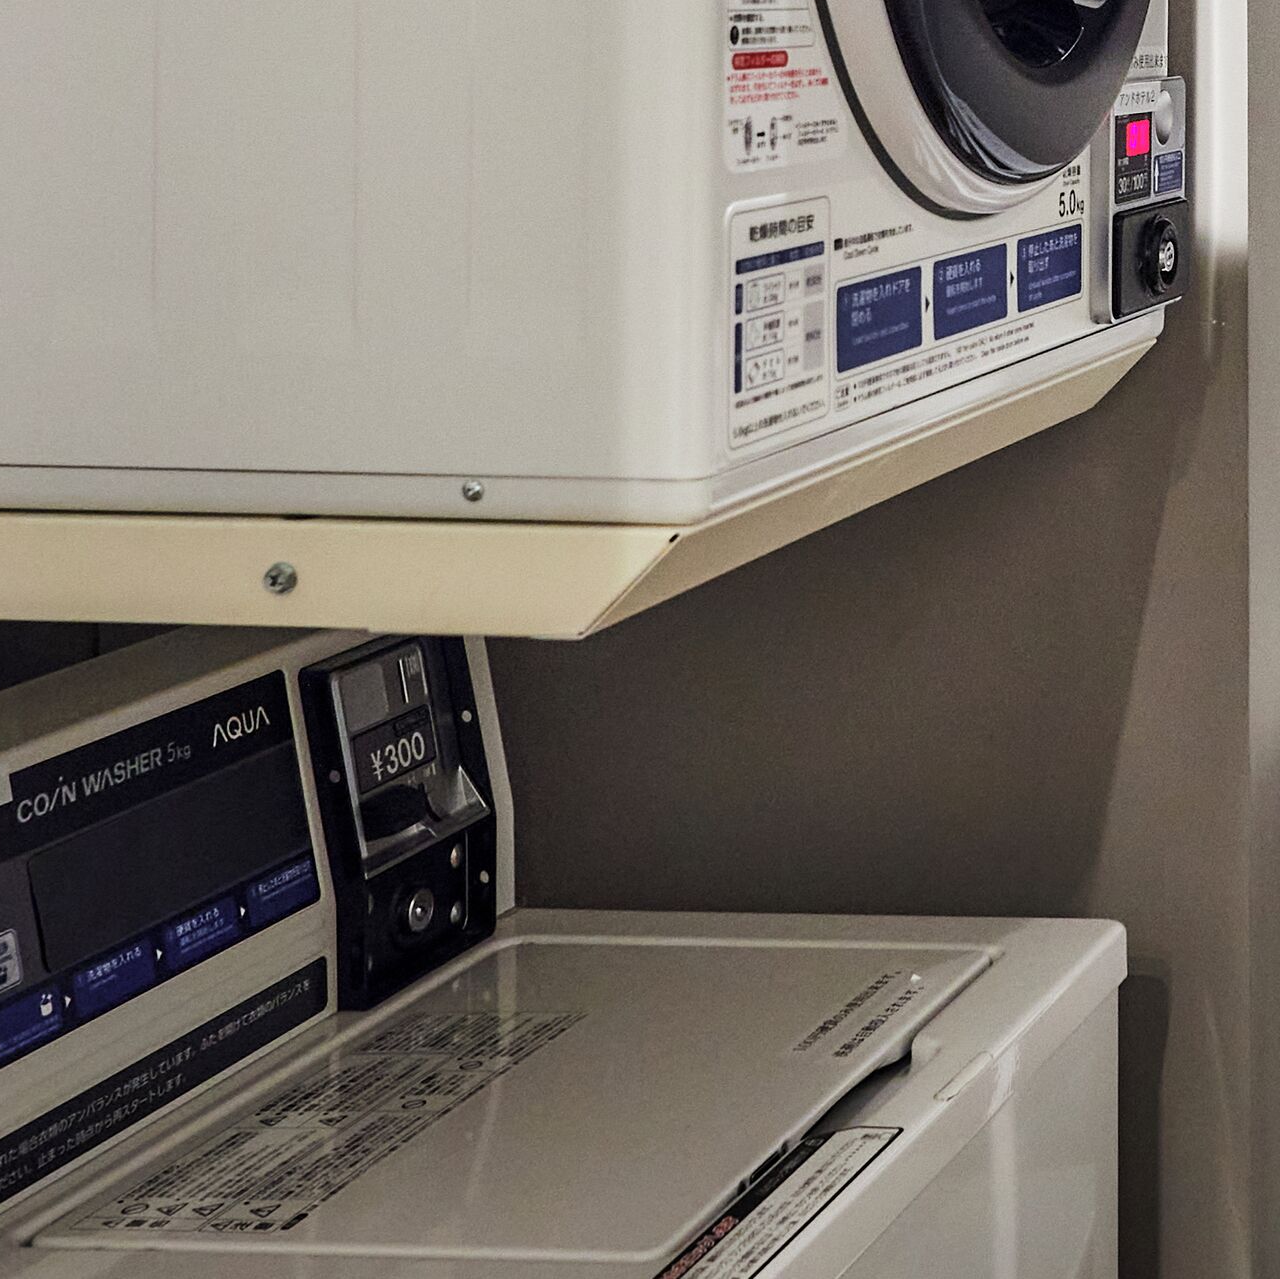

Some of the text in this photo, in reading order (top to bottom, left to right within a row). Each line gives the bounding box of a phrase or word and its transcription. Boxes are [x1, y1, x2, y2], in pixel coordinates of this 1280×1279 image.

[1059, 189, 1085, 217] 5.0kg
[213, 706, 270, 747] AQUA
[82, 747, 162, 796] WASHER
[167, 741, 192, 762] 5kg
[371, 732, 425, 781] ¥300
